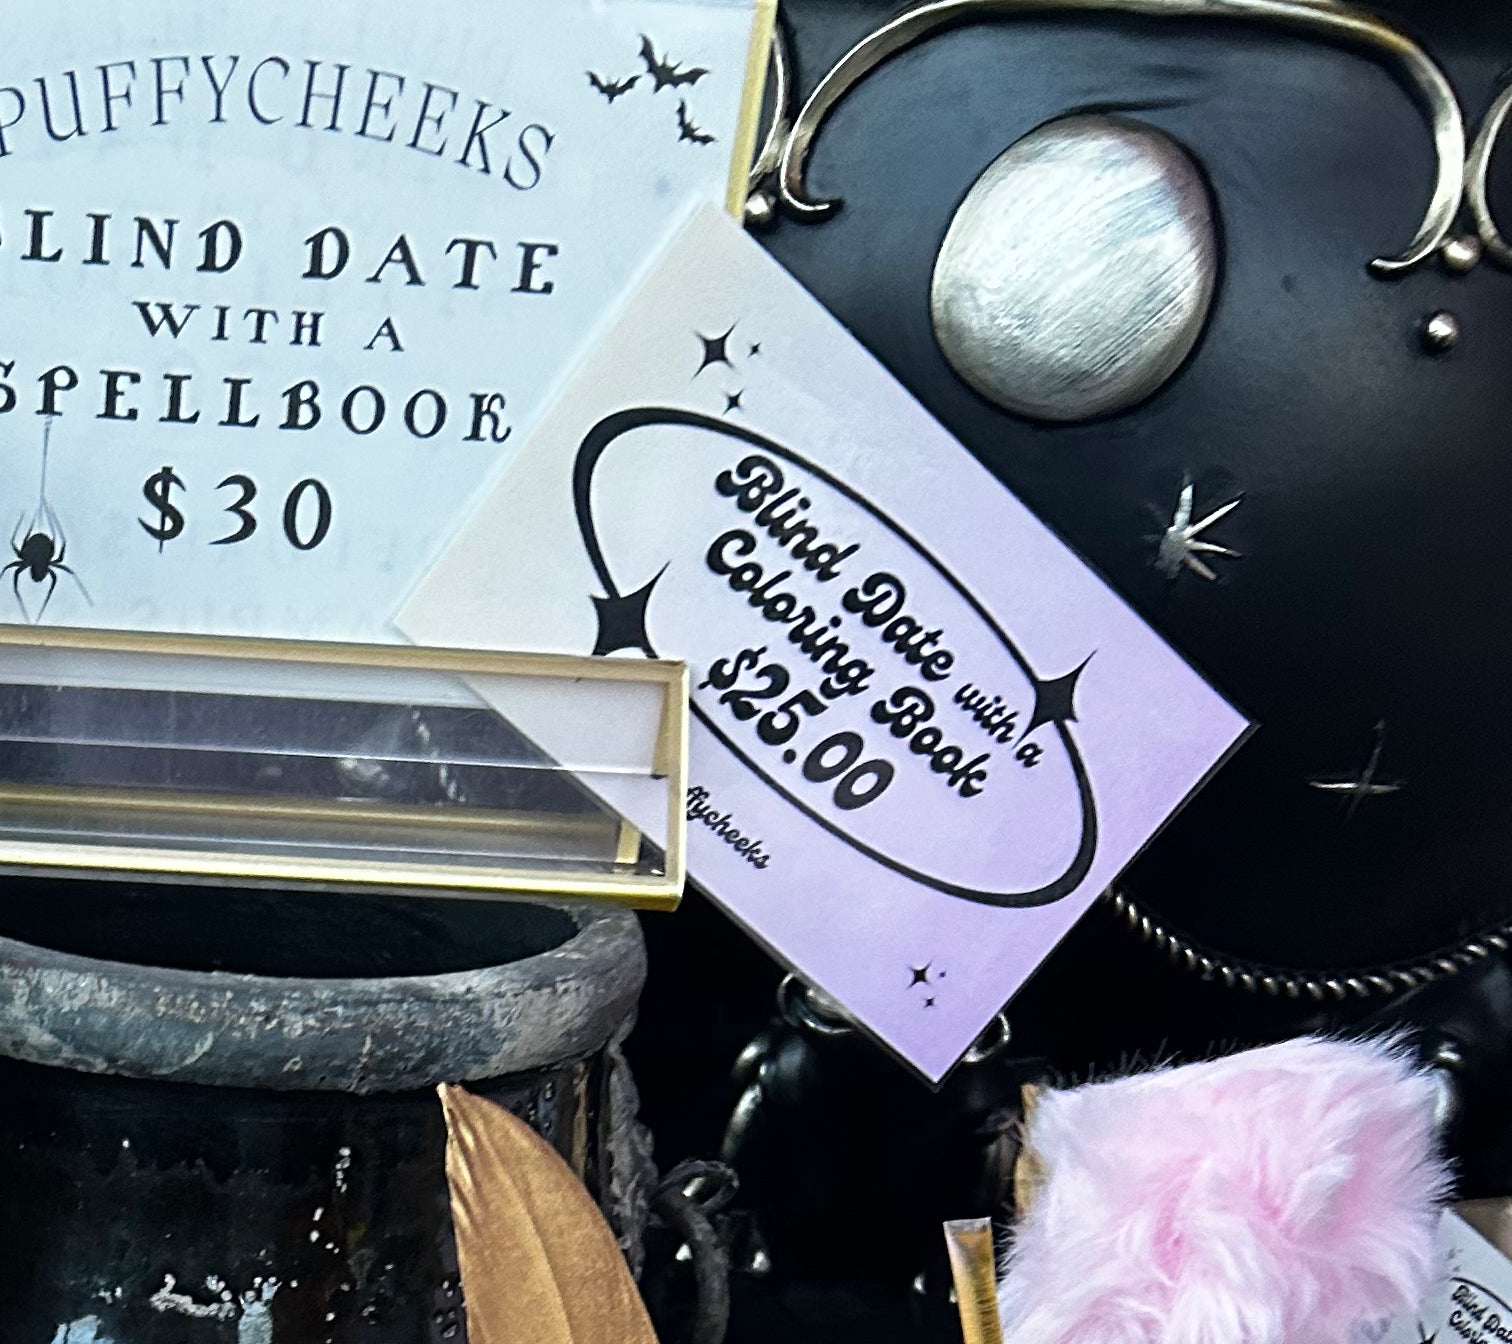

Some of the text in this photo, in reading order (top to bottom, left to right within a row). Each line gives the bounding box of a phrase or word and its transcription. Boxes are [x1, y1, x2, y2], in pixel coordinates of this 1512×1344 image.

[303, 227, 559, 296] DATE
[132, 301, 405, 353] WITH A
[138, 465, 332, 554] $30
[715, 455, 1043, 768] Blind Date with a
[706, 529, 991, 798] Coloring Book
[698, 646, 895, 811] $25.00
[686, 786, 770, 869] ffycheeks
